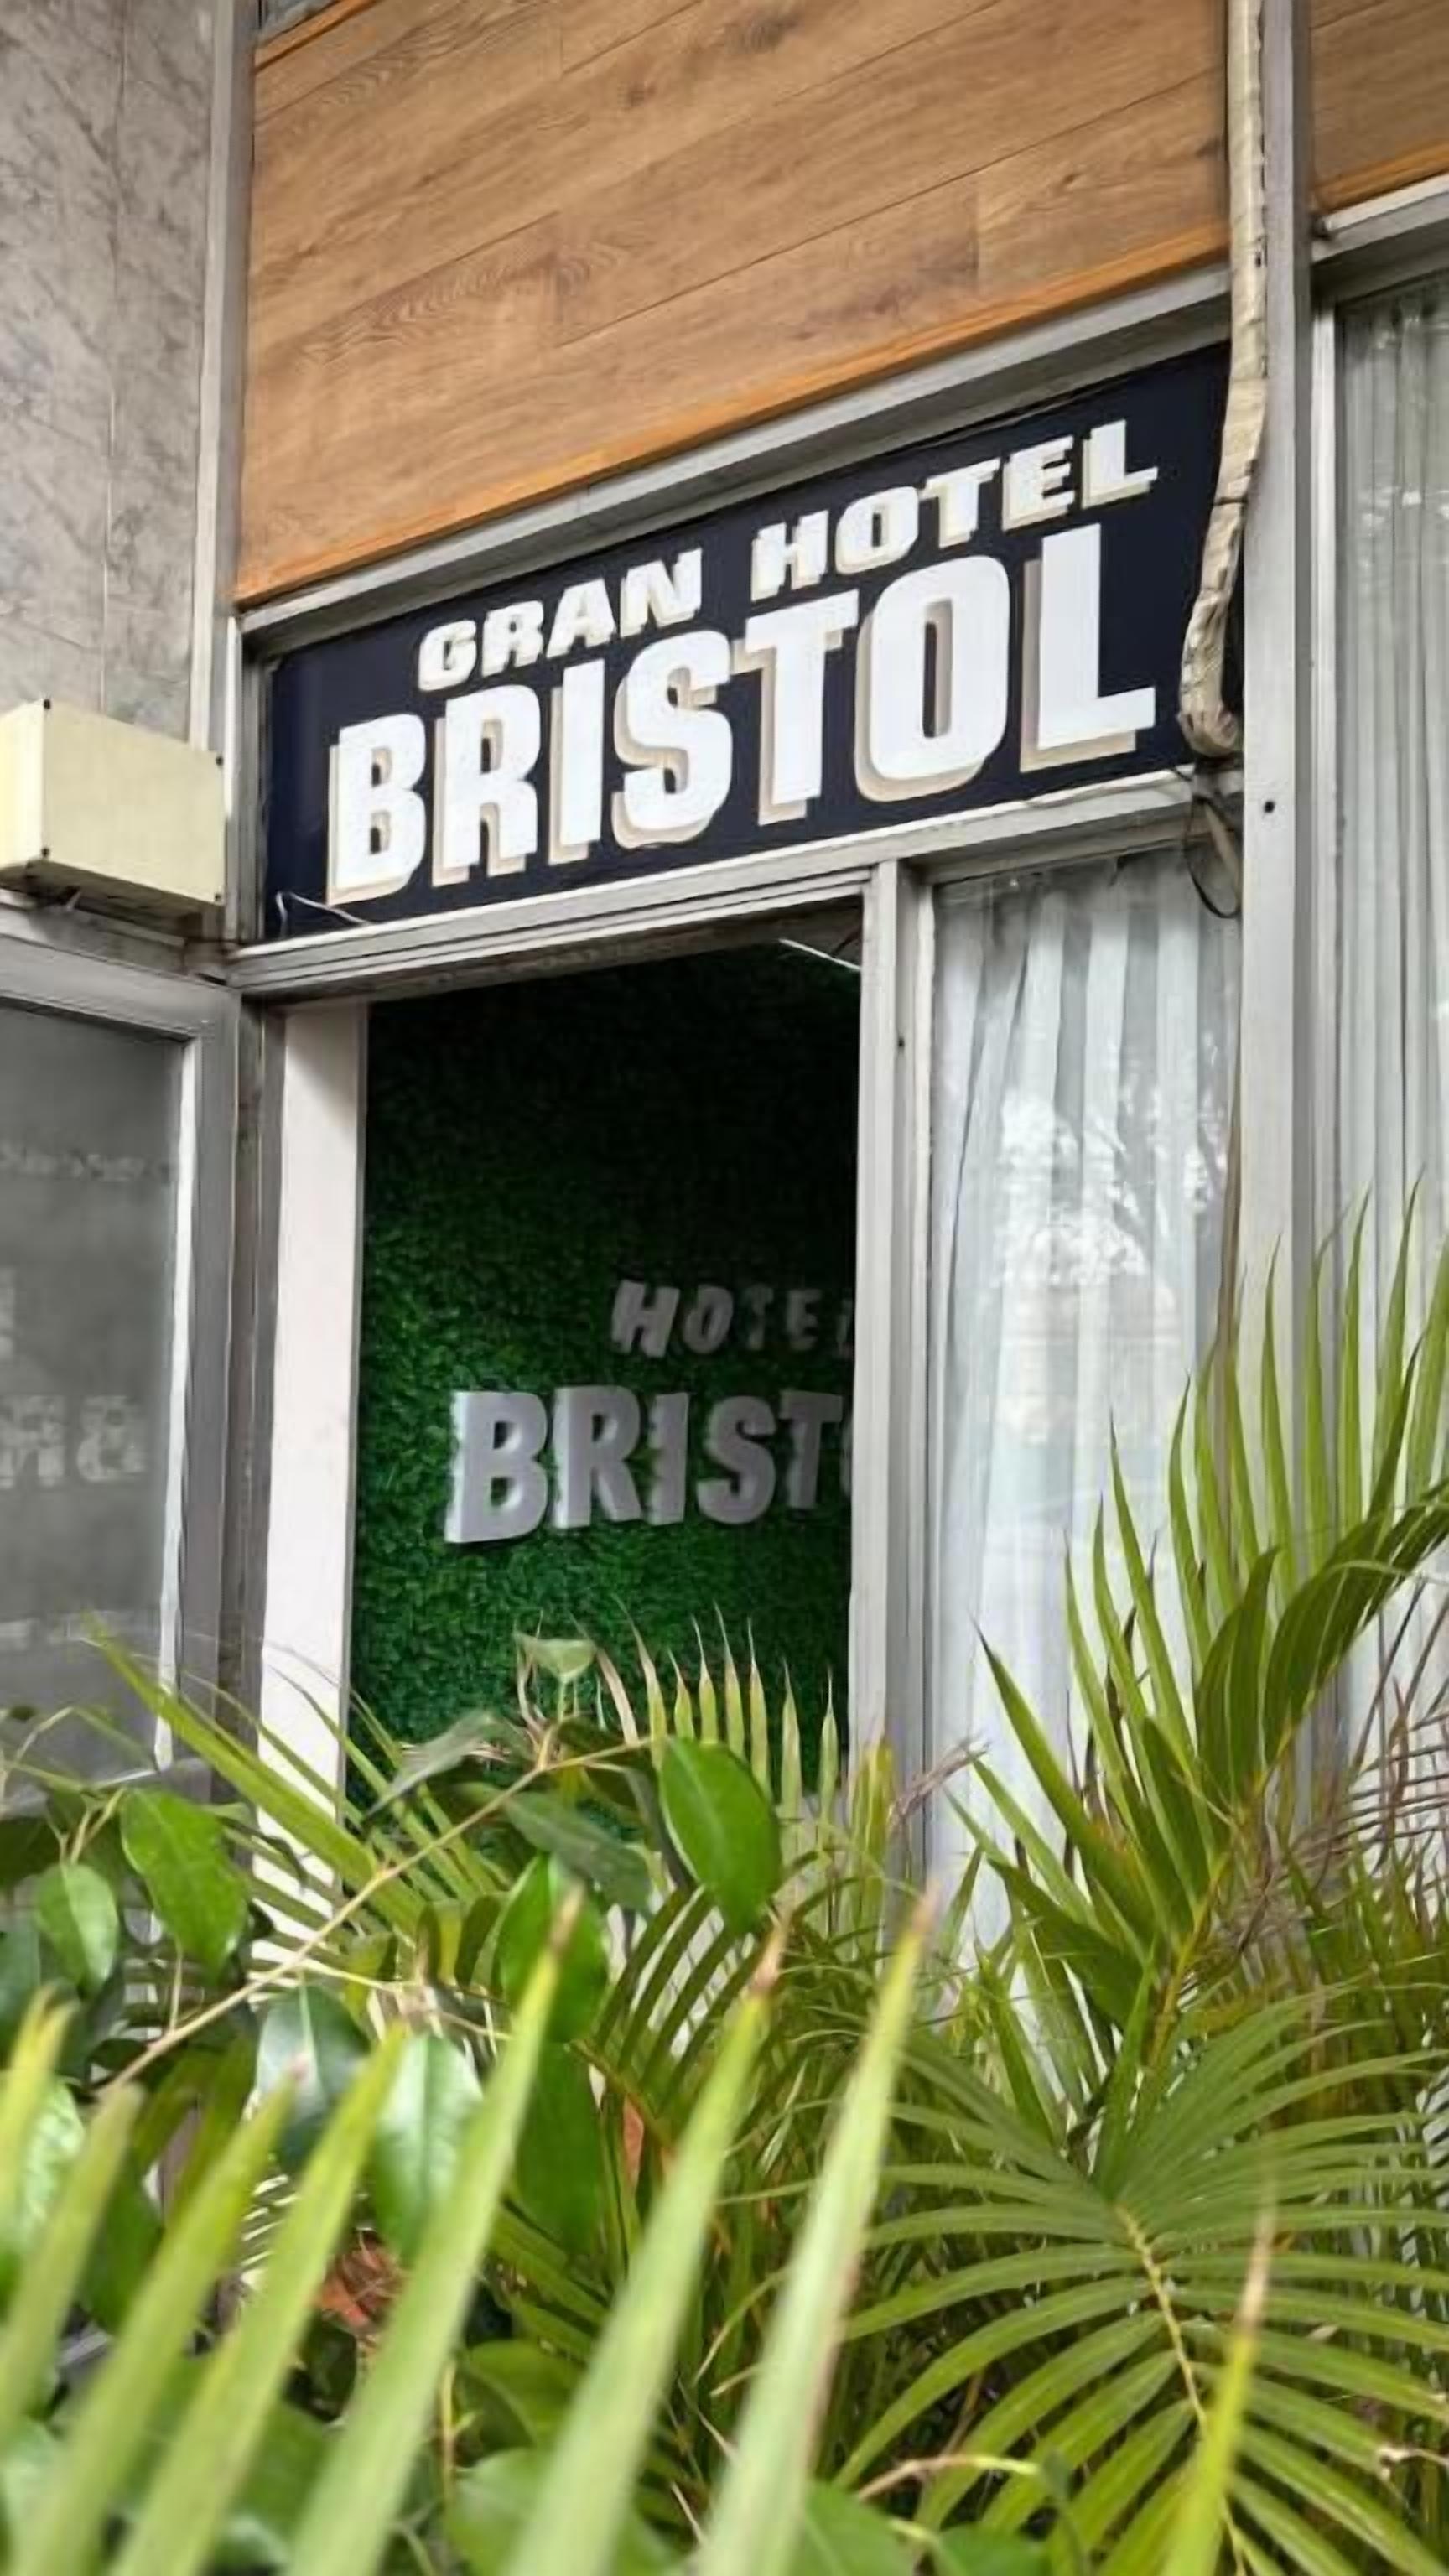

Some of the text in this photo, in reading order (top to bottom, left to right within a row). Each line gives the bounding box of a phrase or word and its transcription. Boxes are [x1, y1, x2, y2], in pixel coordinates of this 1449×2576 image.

[417, 419, 1159, 691] GRAN HOTEL
[326, 522, 1156, 906] BRISTOL
[444, 1384, 852, 1544] BRIST
